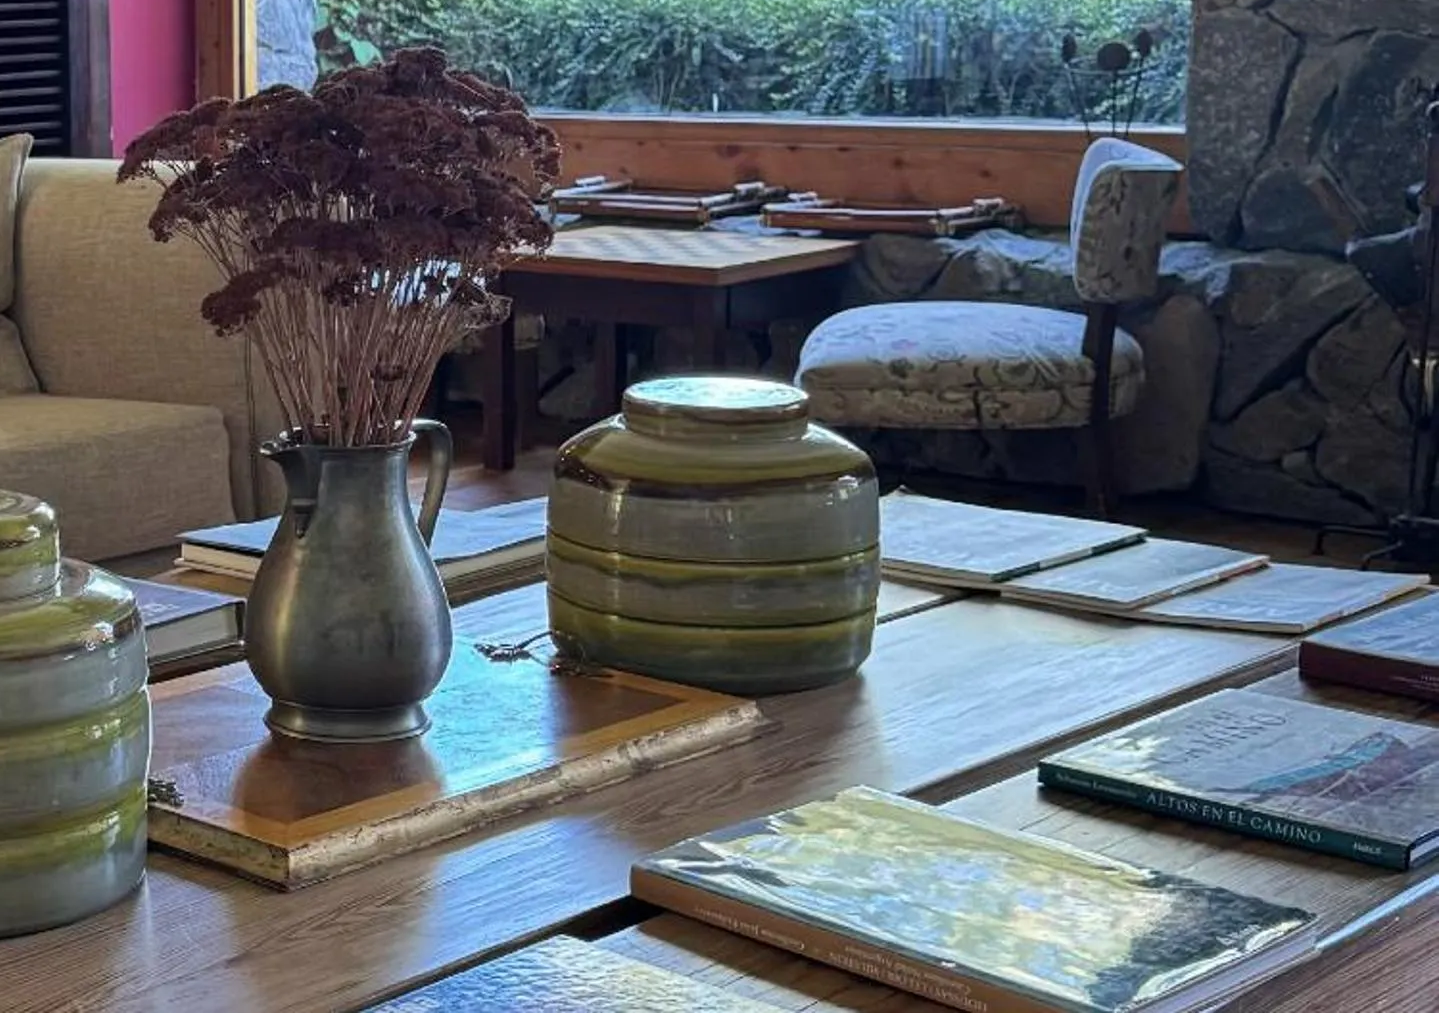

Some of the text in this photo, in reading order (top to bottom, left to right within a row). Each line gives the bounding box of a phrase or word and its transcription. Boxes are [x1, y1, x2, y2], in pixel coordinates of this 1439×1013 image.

[1146, 792, 1322, 844] ALTOS EN EL CAMINO
